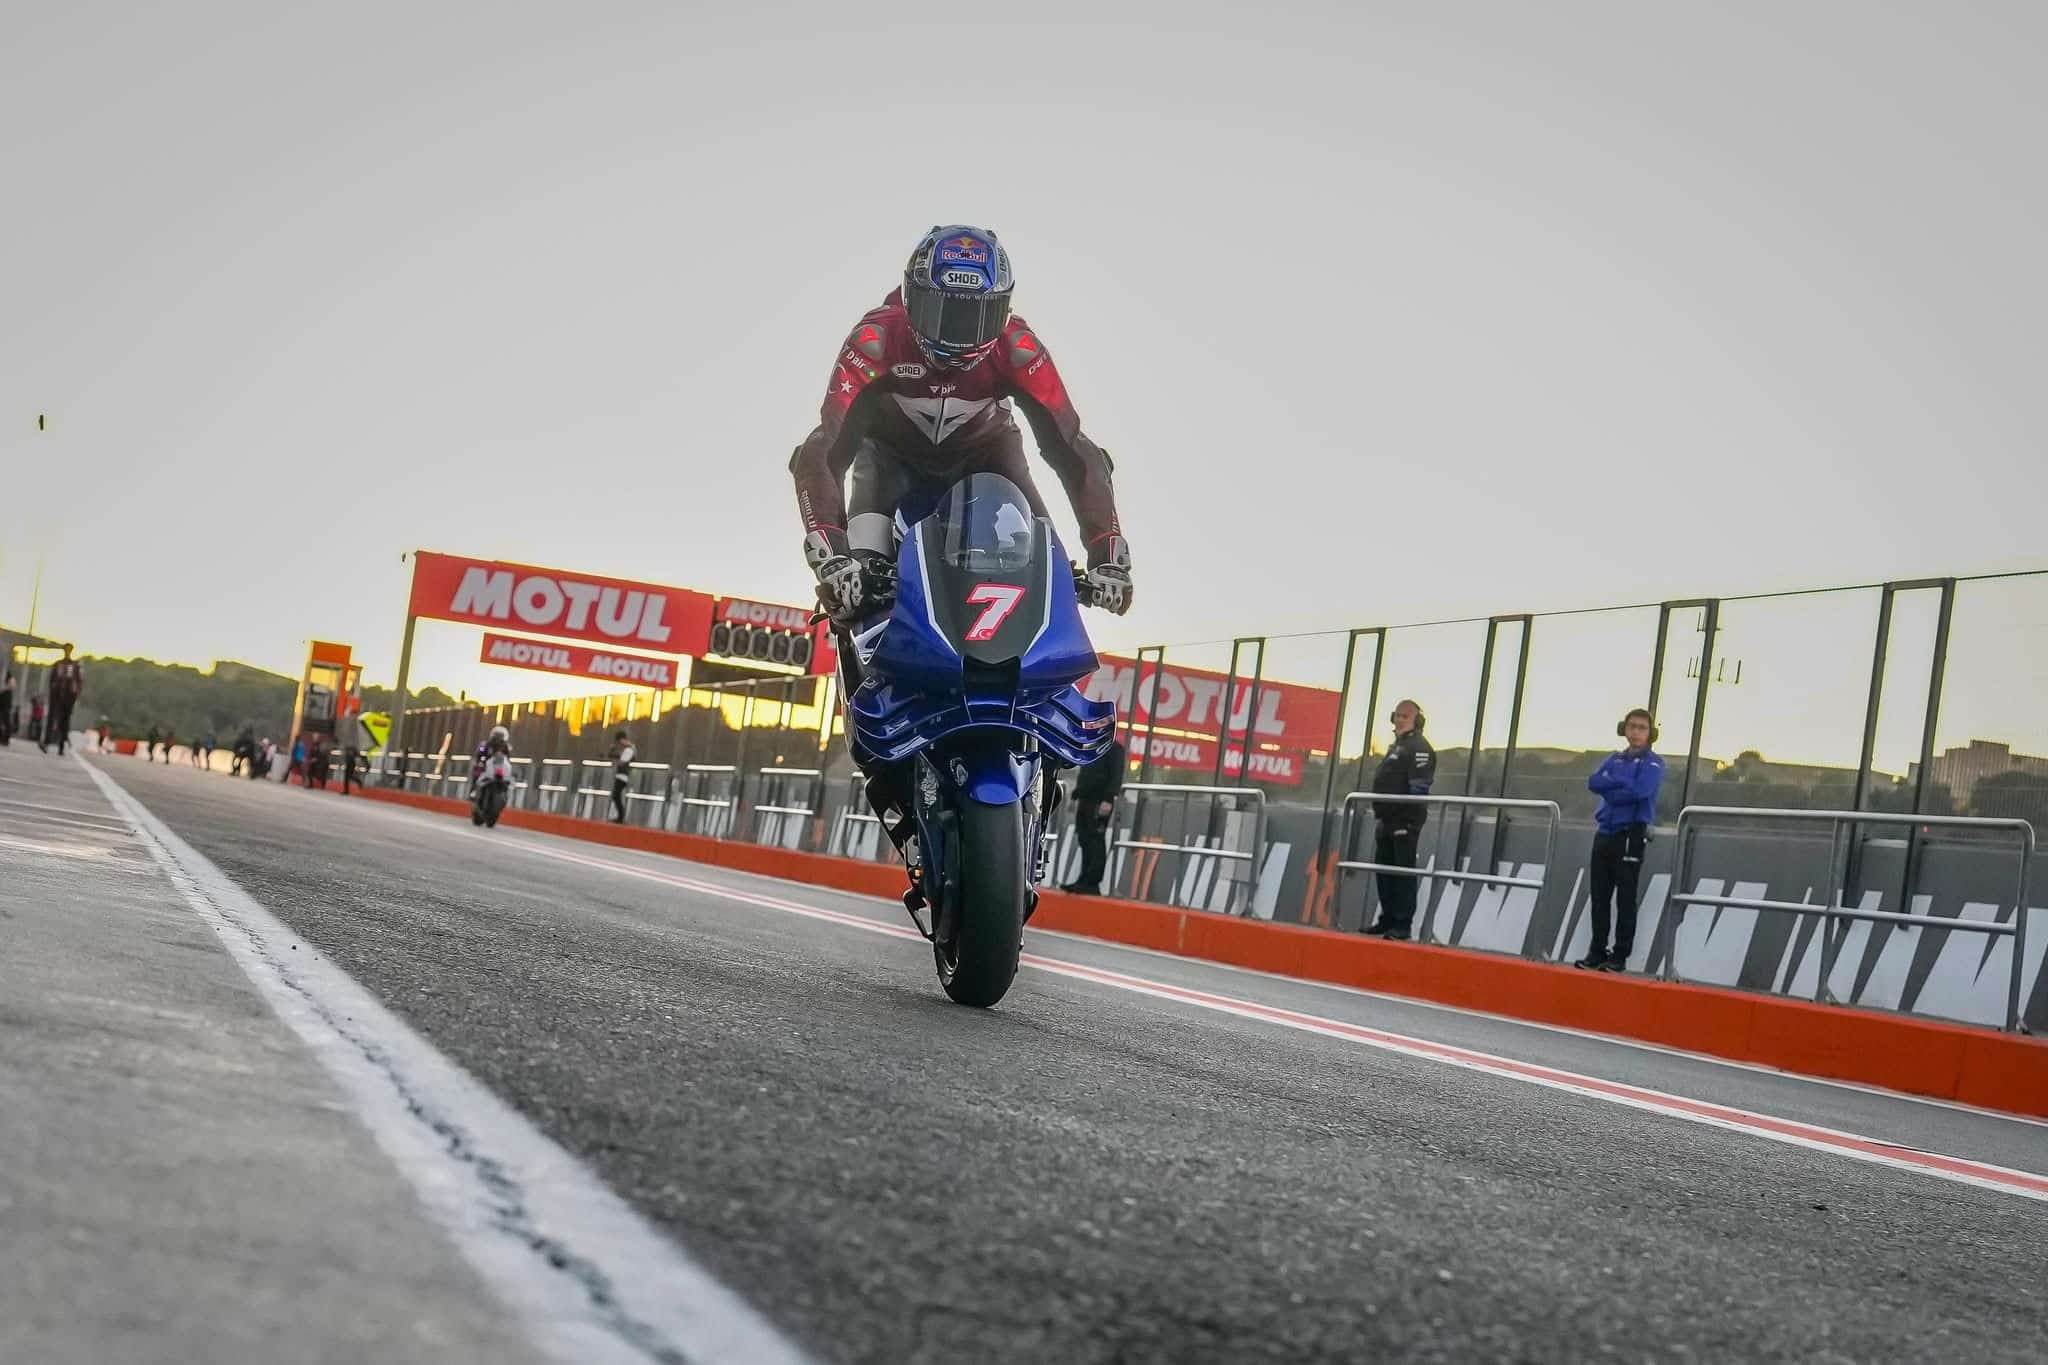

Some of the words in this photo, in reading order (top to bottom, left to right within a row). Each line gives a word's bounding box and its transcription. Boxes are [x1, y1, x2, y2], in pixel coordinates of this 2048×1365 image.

[947, 272, 980, 285] SHOEI
[897, 367, 921, 376] SHOEI
[450, 566, 671, 643] MOTUL
[724, 600, 808, 629] MOTUL
[965, 583, 1026, 641] 7
[489, 640, 571, 669] MOTUL
[589, 655, 670, 684] MOTUL
[1083, 663, 1287, 736] MOTUL
[1130, 736, 1201, 763] MOTUL
